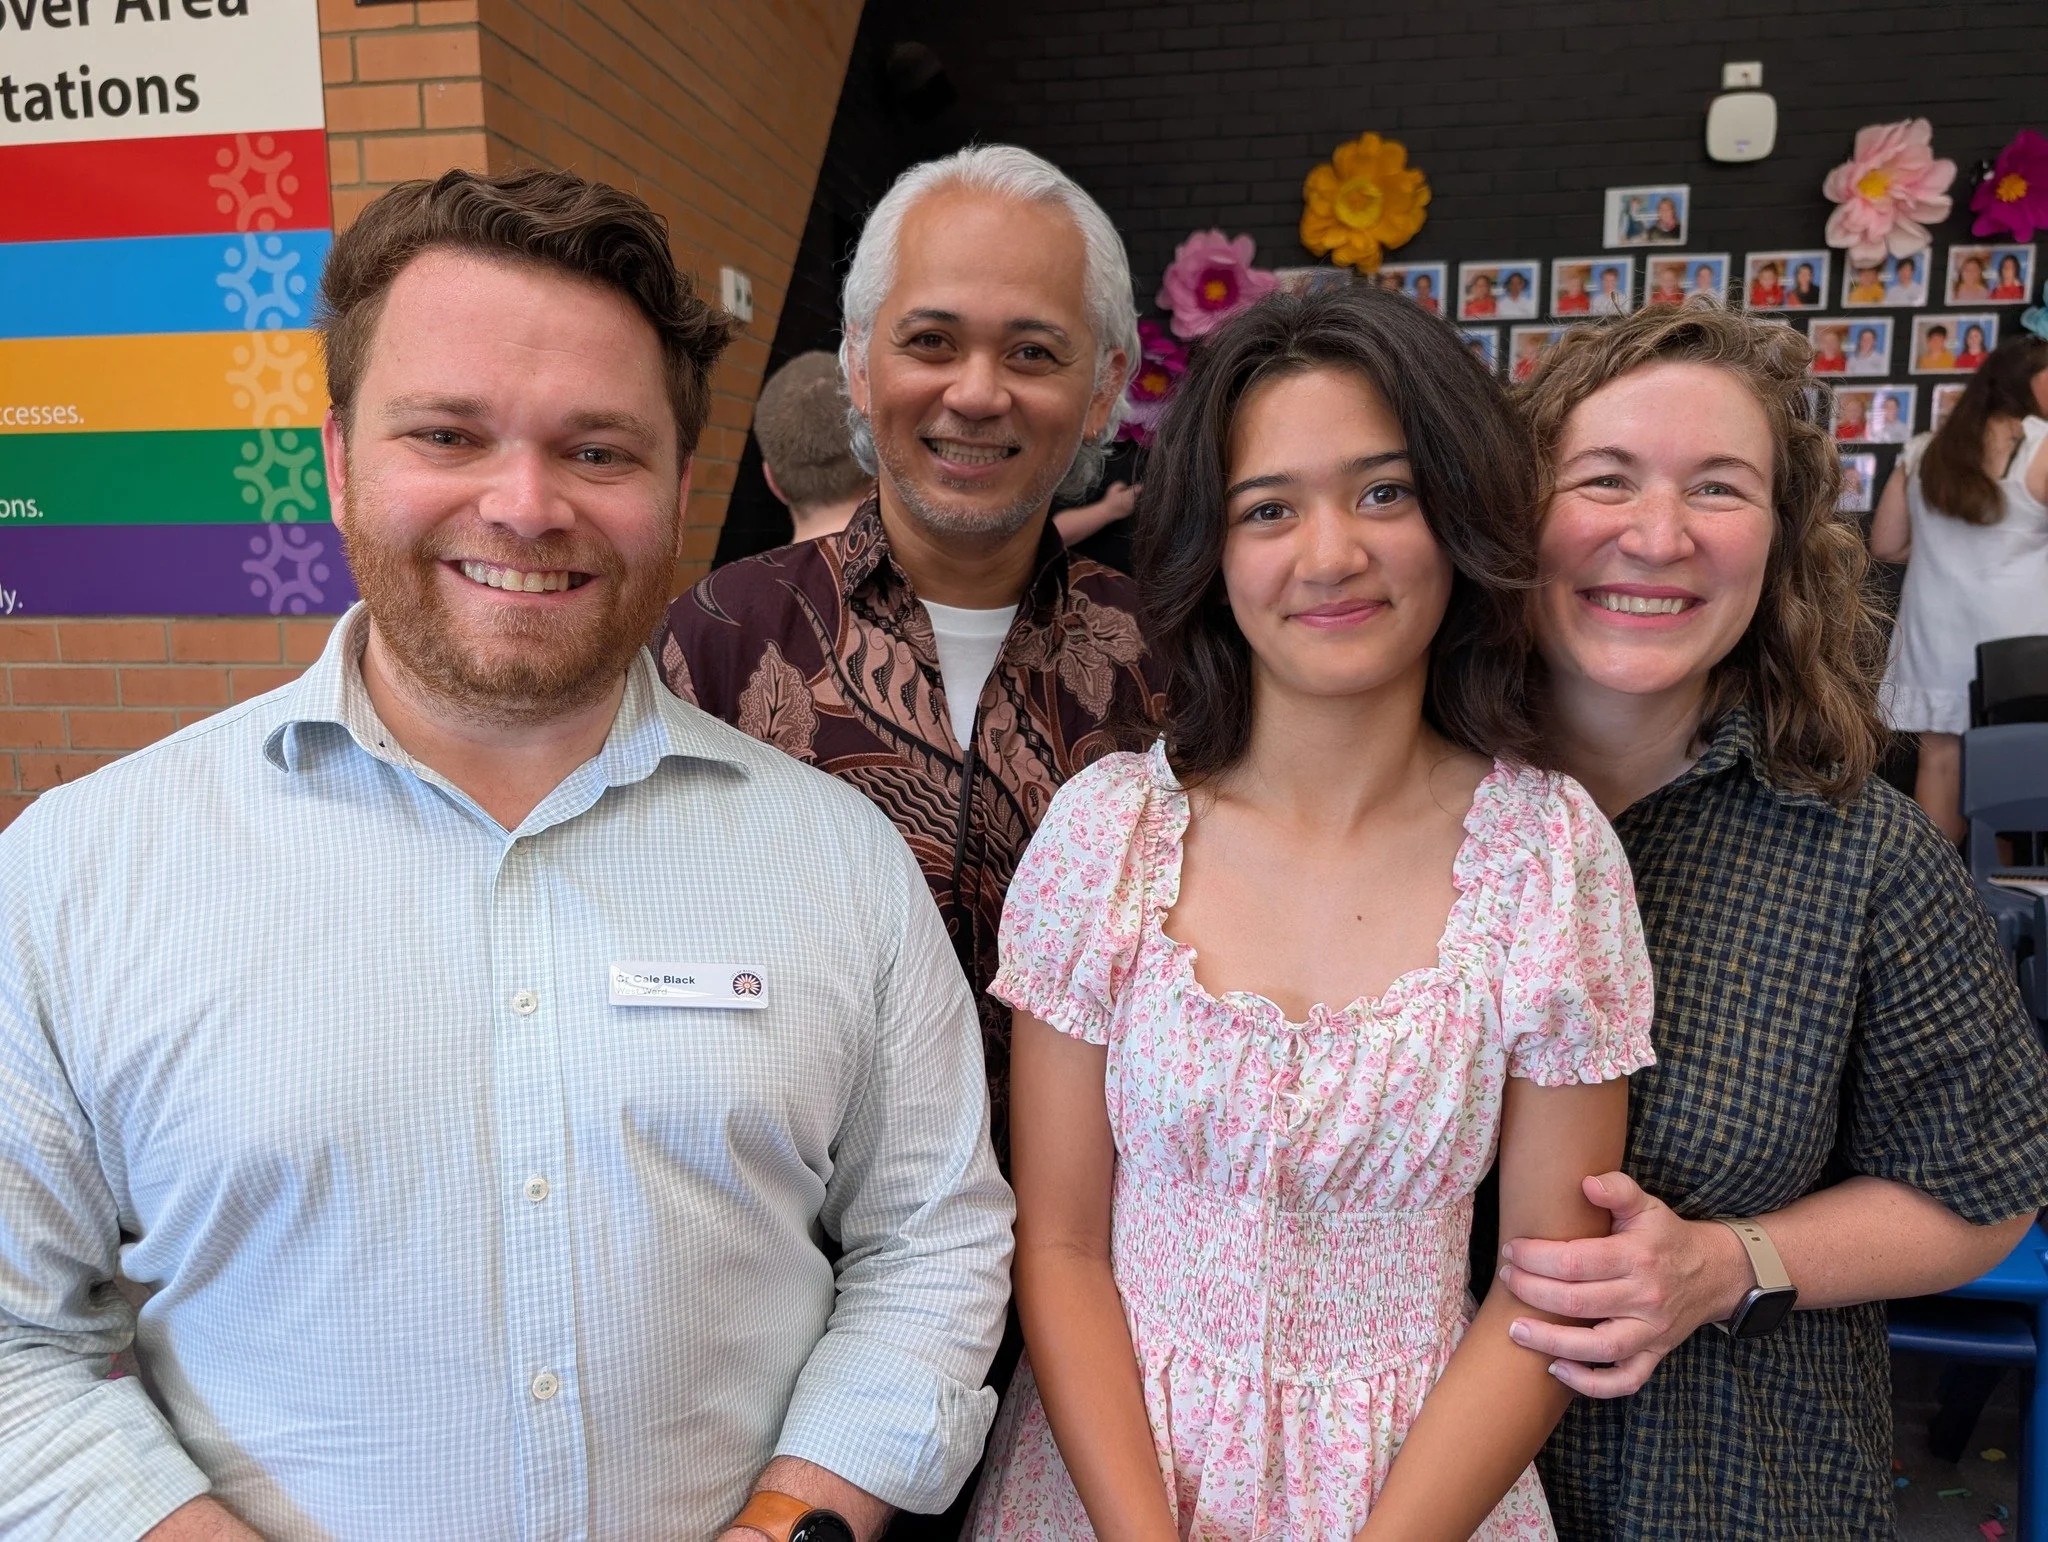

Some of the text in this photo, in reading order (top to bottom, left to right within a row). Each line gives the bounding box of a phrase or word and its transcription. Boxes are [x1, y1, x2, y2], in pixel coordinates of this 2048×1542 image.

[0, 0, 89, 31] ver
[0, 64, 200, 123] tations
[0, 405, 84, 426] cesses.
[633, 974, 660, 984] Cale
[664, 975, 695, 984] Black
